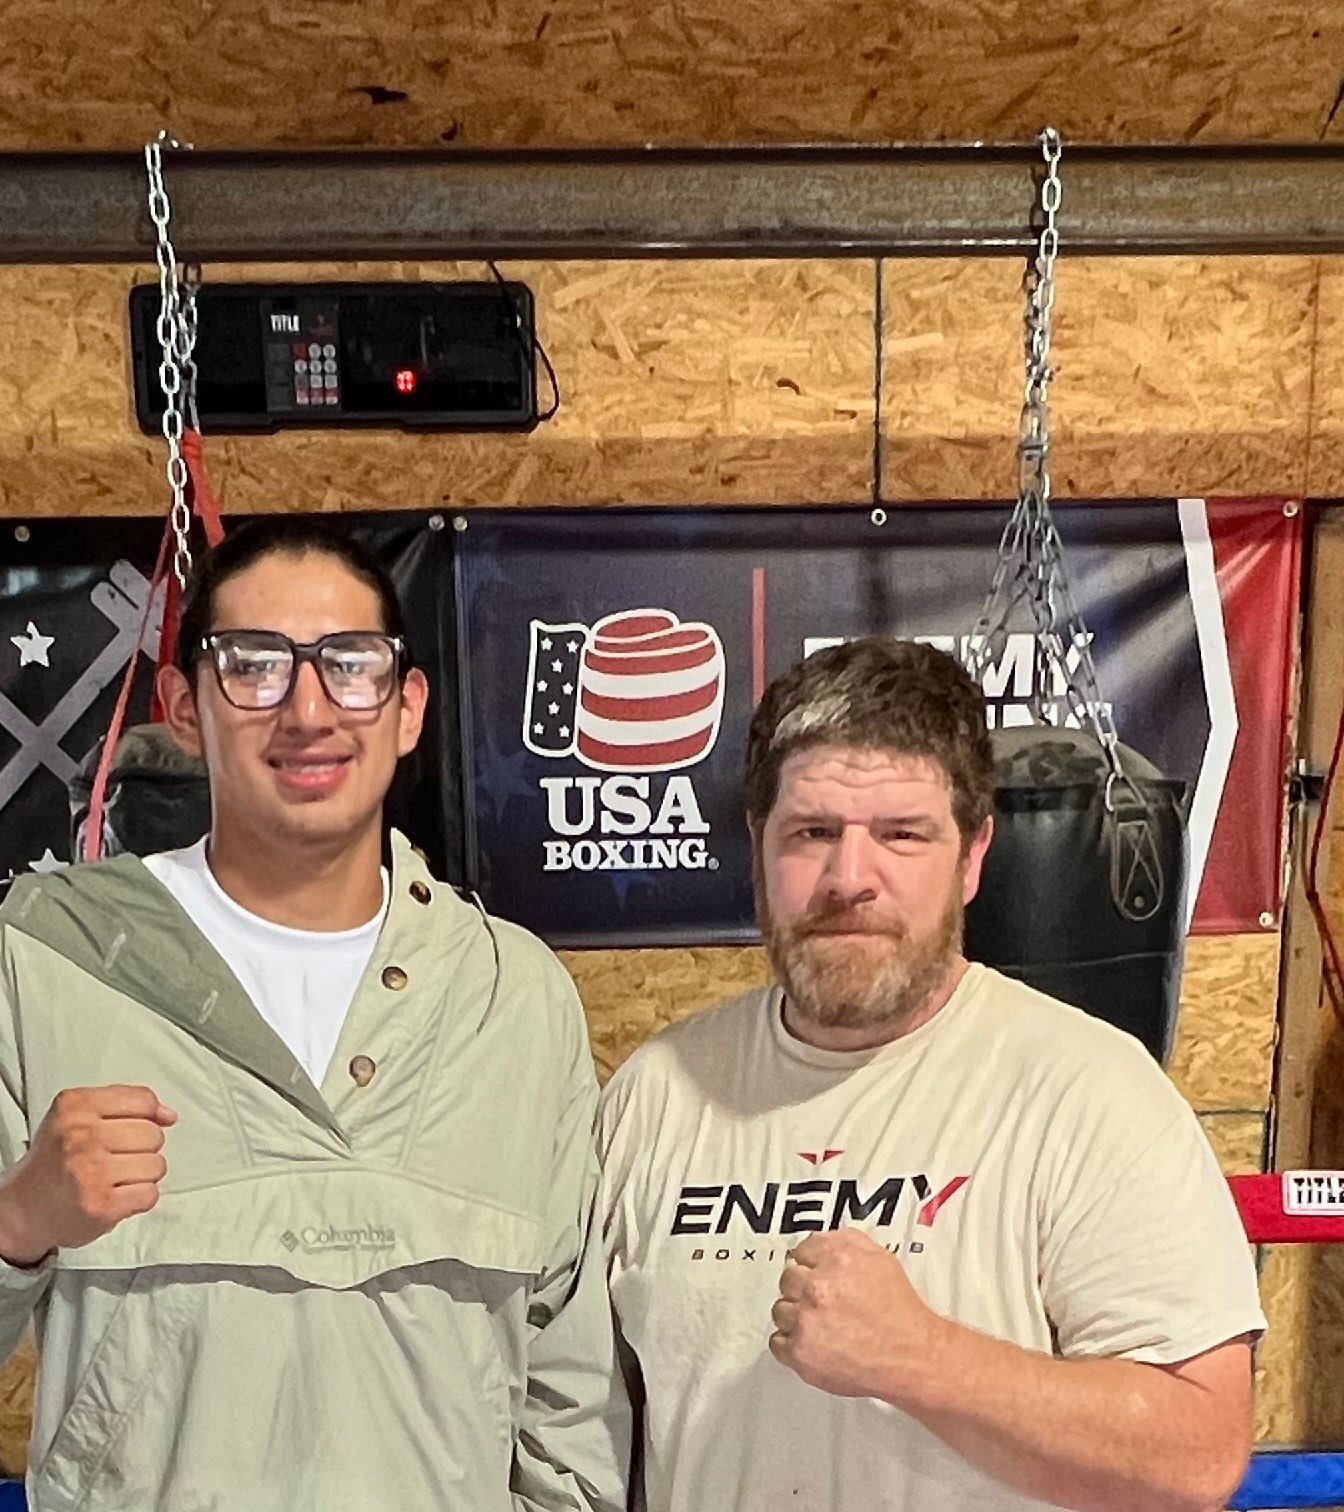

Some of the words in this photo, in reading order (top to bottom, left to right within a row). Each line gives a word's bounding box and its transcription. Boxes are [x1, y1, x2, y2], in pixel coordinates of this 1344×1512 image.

[539, 774, 710, 836] USA
[542, 838, 709, 871] BOXING
[670, 1173, 971, 1236] ENEMY
